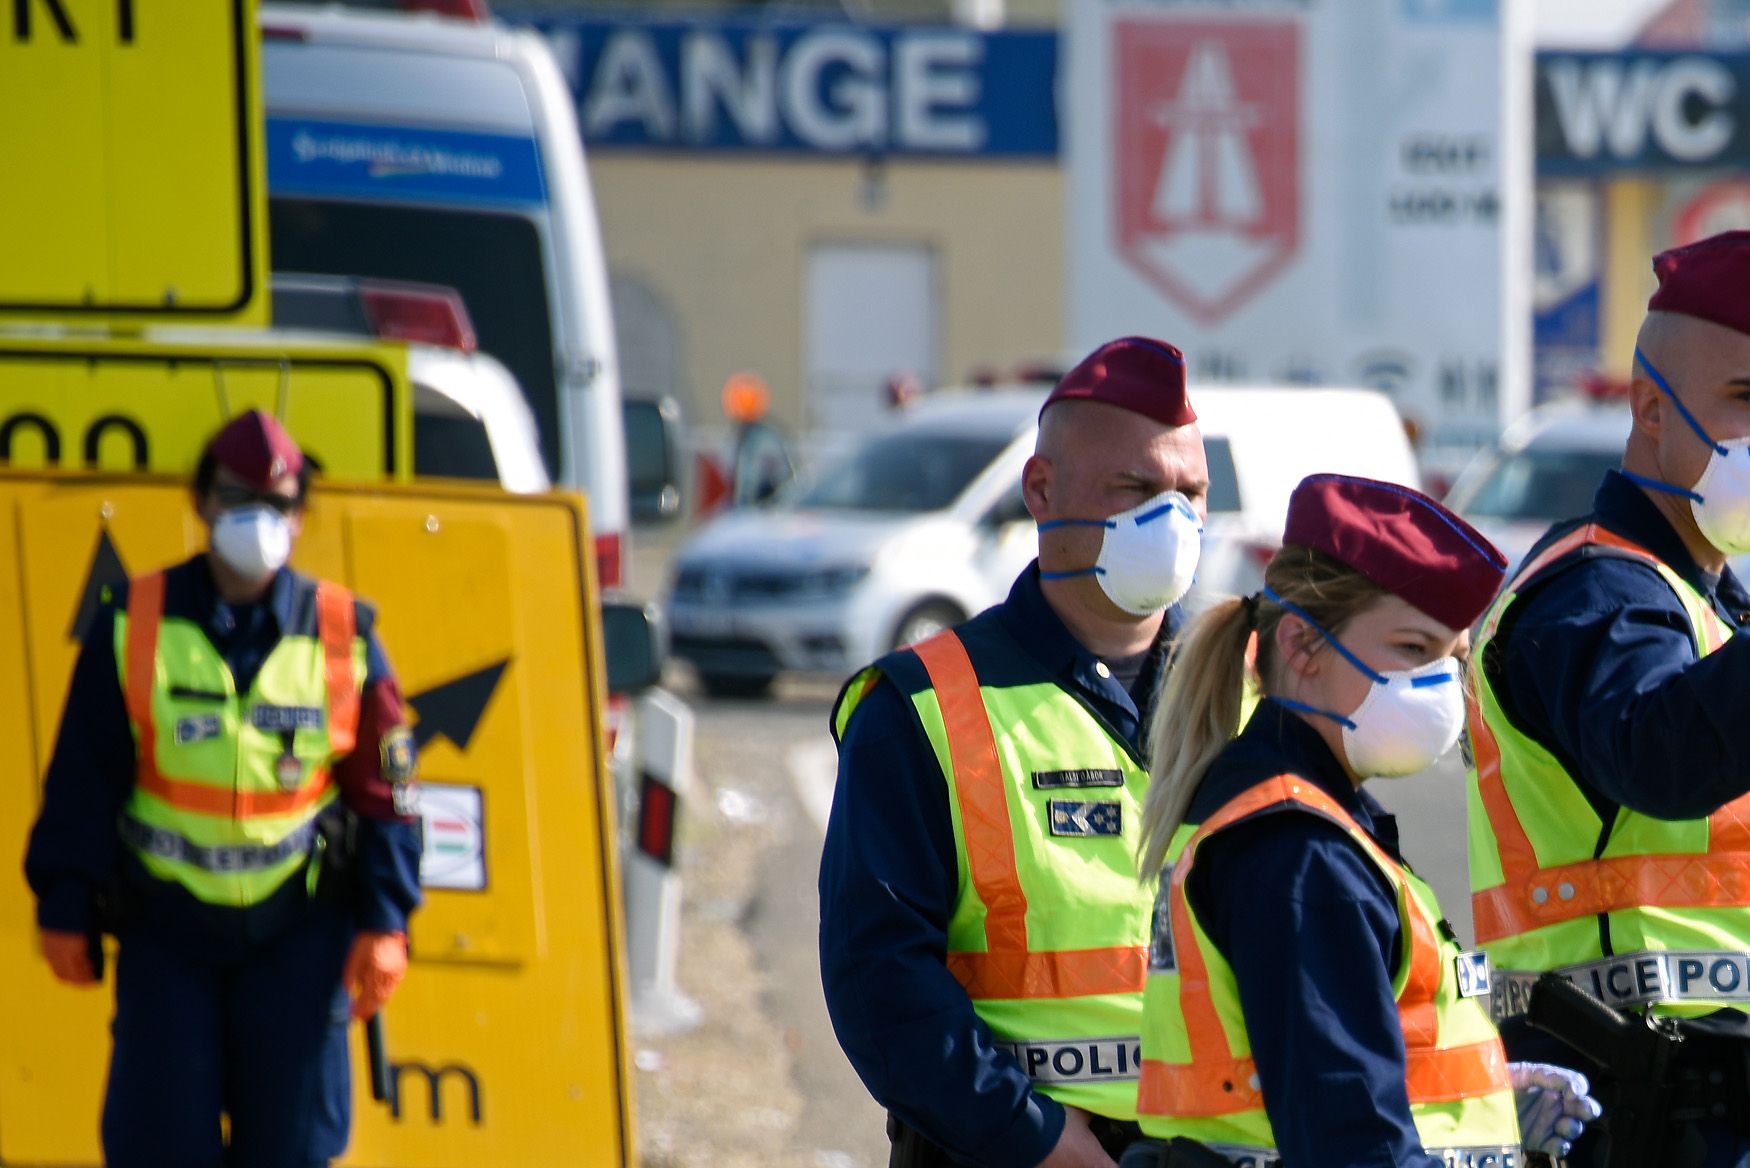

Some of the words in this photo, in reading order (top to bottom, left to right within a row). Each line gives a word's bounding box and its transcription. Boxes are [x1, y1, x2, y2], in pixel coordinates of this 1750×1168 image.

[555, 25, 988, 150] ANGE
[1547, 56, 1737, 162] WC
[1026, 1044, 1141, 1077] POLI
